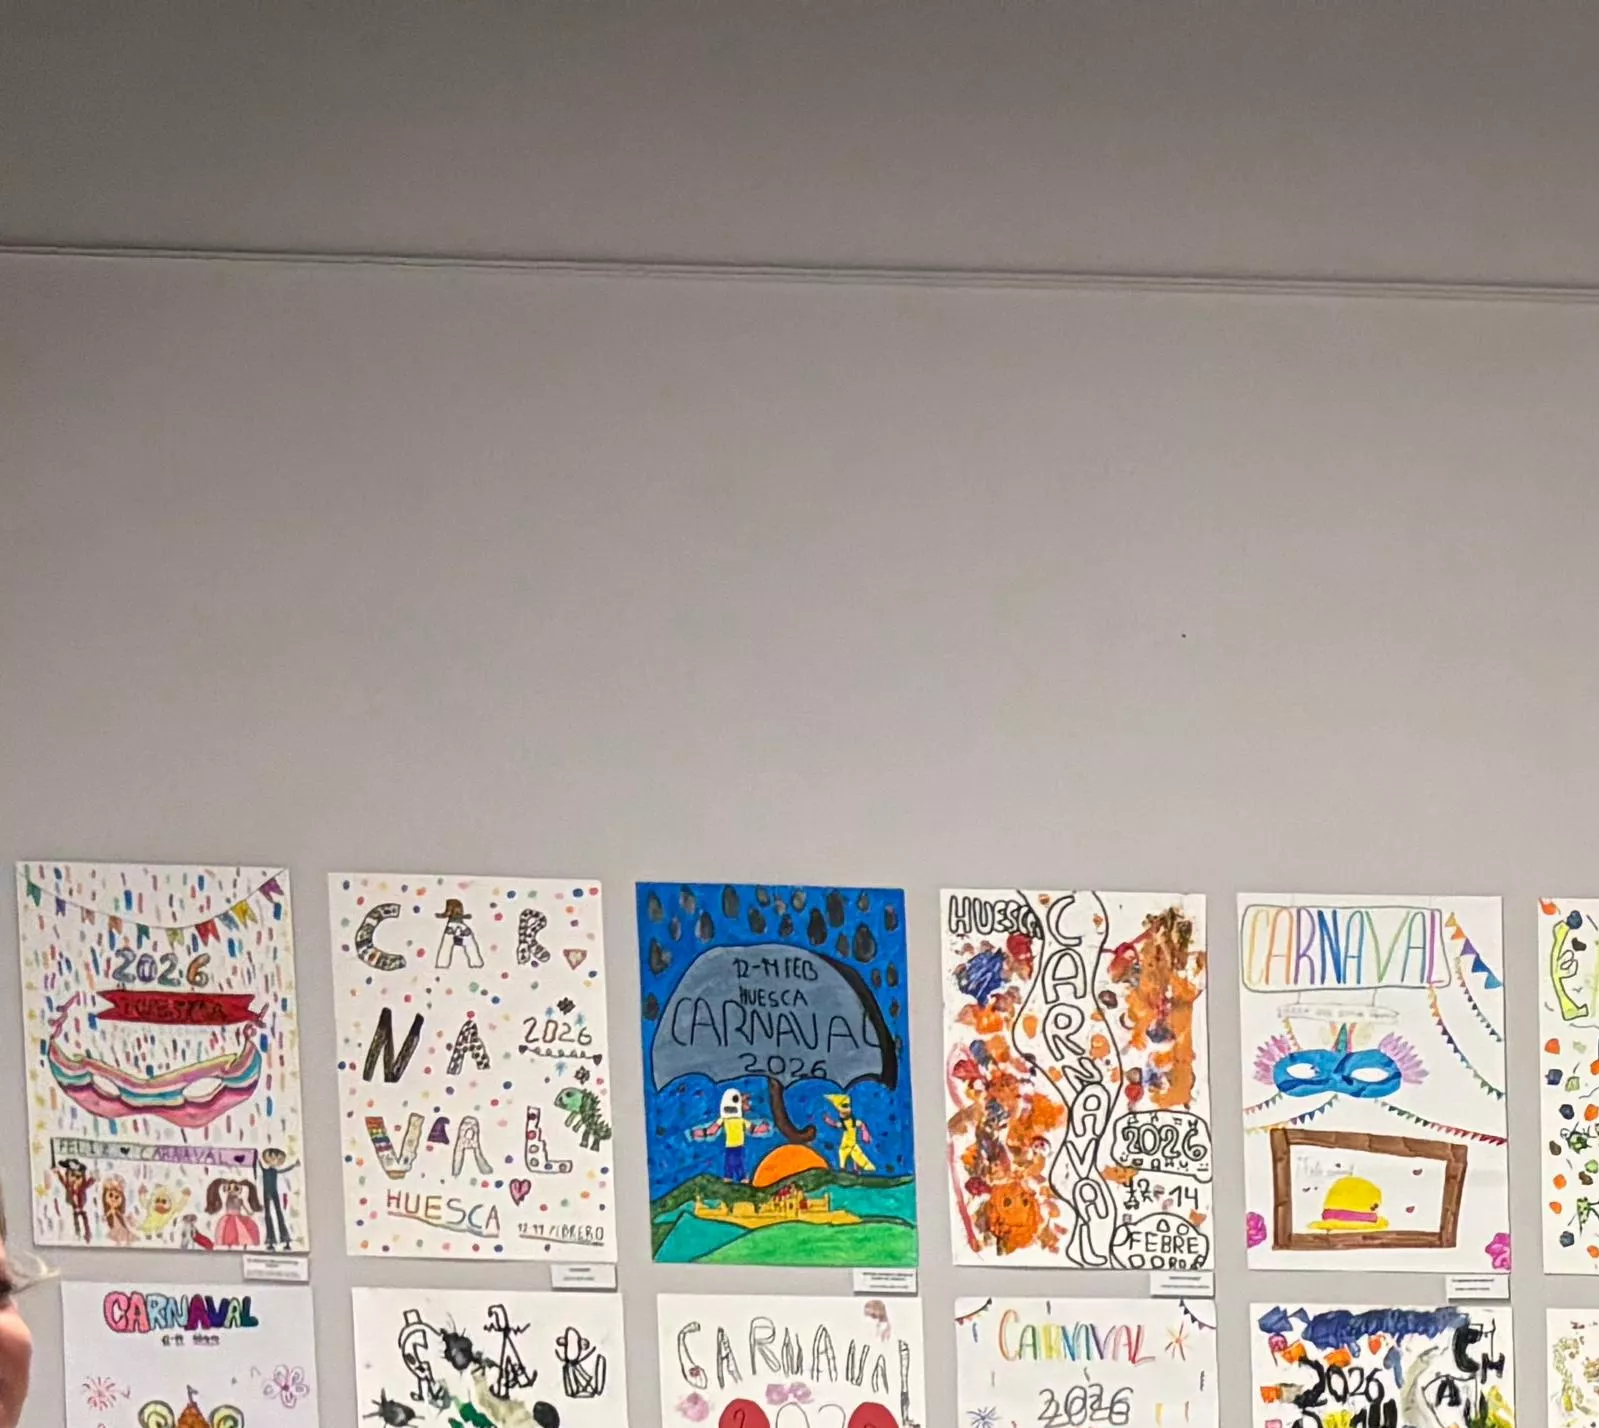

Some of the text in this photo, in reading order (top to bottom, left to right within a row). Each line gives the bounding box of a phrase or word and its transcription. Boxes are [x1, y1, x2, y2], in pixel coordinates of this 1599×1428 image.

[112, 947, 211, 988] 2026
[1248, 908, 1445, 987] CARNAVAL
[740, 985, 808, 1008] HUESCA
[521, 1017, 593, 1046] 2026
[739, 1052, 828, 1079] 2026
[1124, 1123, 1208, 1163] 2026
[386, 1189, 500, 1230] HUESCA
[103, 1290, 260, 1334] CARNAVAL
[1000, 1310, 1155, 1365] CARNAVAL
